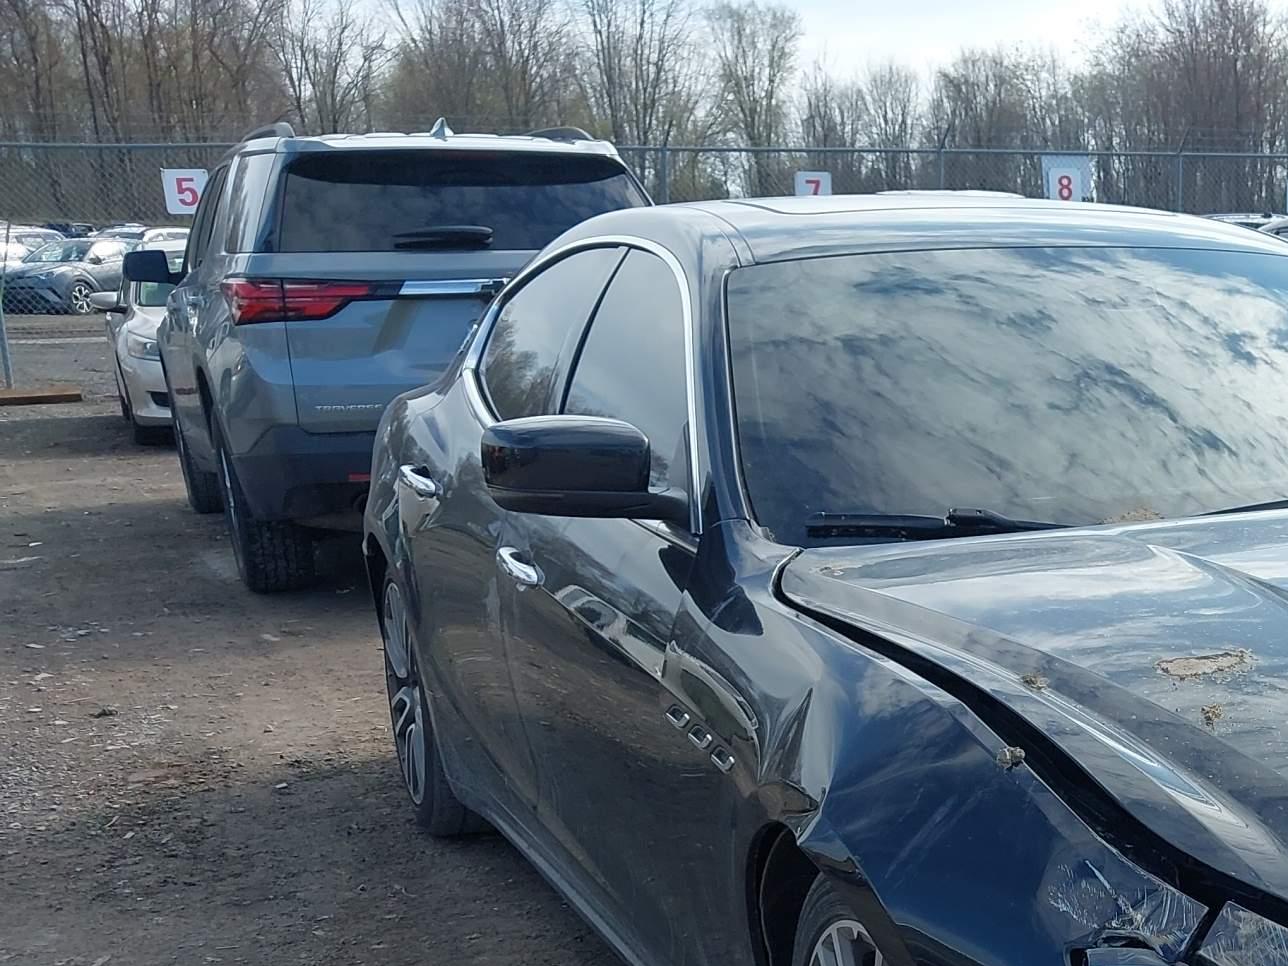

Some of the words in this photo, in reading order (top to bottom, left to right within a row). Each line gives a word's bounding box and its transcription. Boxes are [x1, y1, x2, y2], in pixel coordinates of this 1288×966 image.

[175, 177, 199, 207] 5
[805, 179, 821, 196] 7
[1057, 175, 1073, 201] 8
